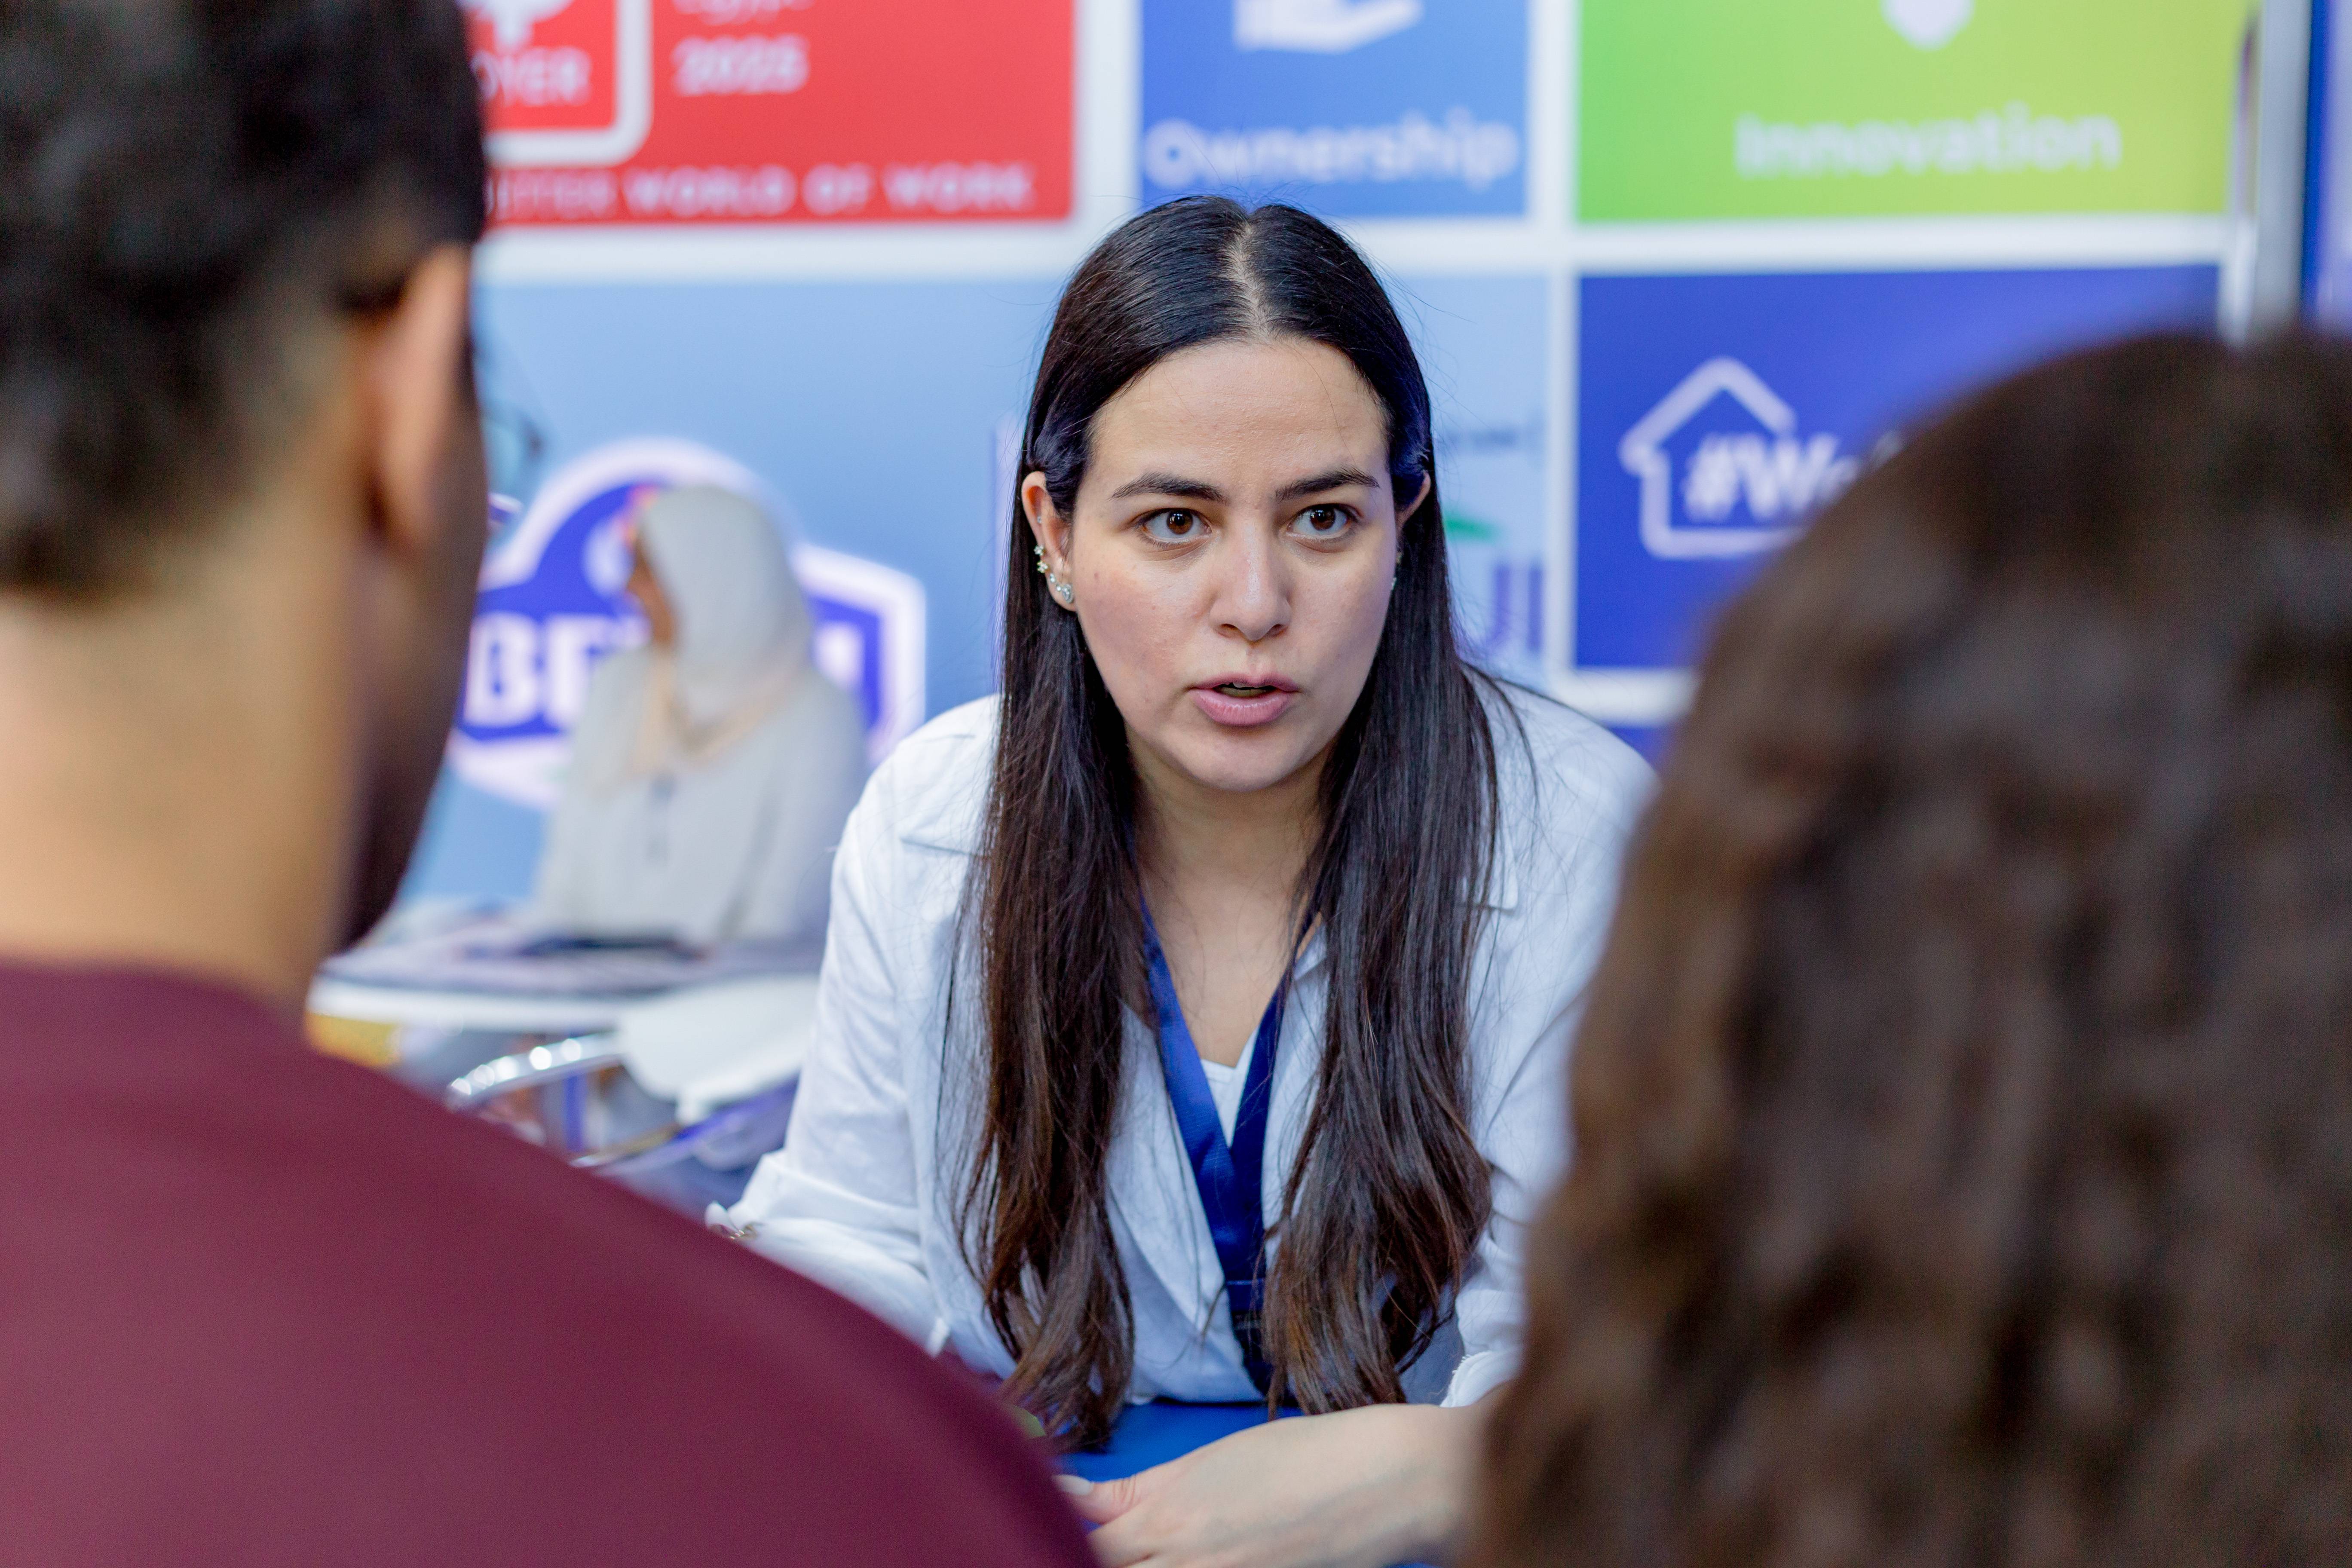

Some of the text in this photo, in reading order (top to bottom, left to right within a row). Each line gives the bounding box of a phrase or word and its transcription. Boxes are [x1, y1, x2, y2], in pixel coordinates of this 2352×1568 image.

[1147, 110, 1517, 191] Ownership
[1736, 102, 2121, 178] Innovation
[624, 166, 793, 215] WORLD
[804, 164, 869, 213] OF
[884, 163, 1033, 212] WORK
